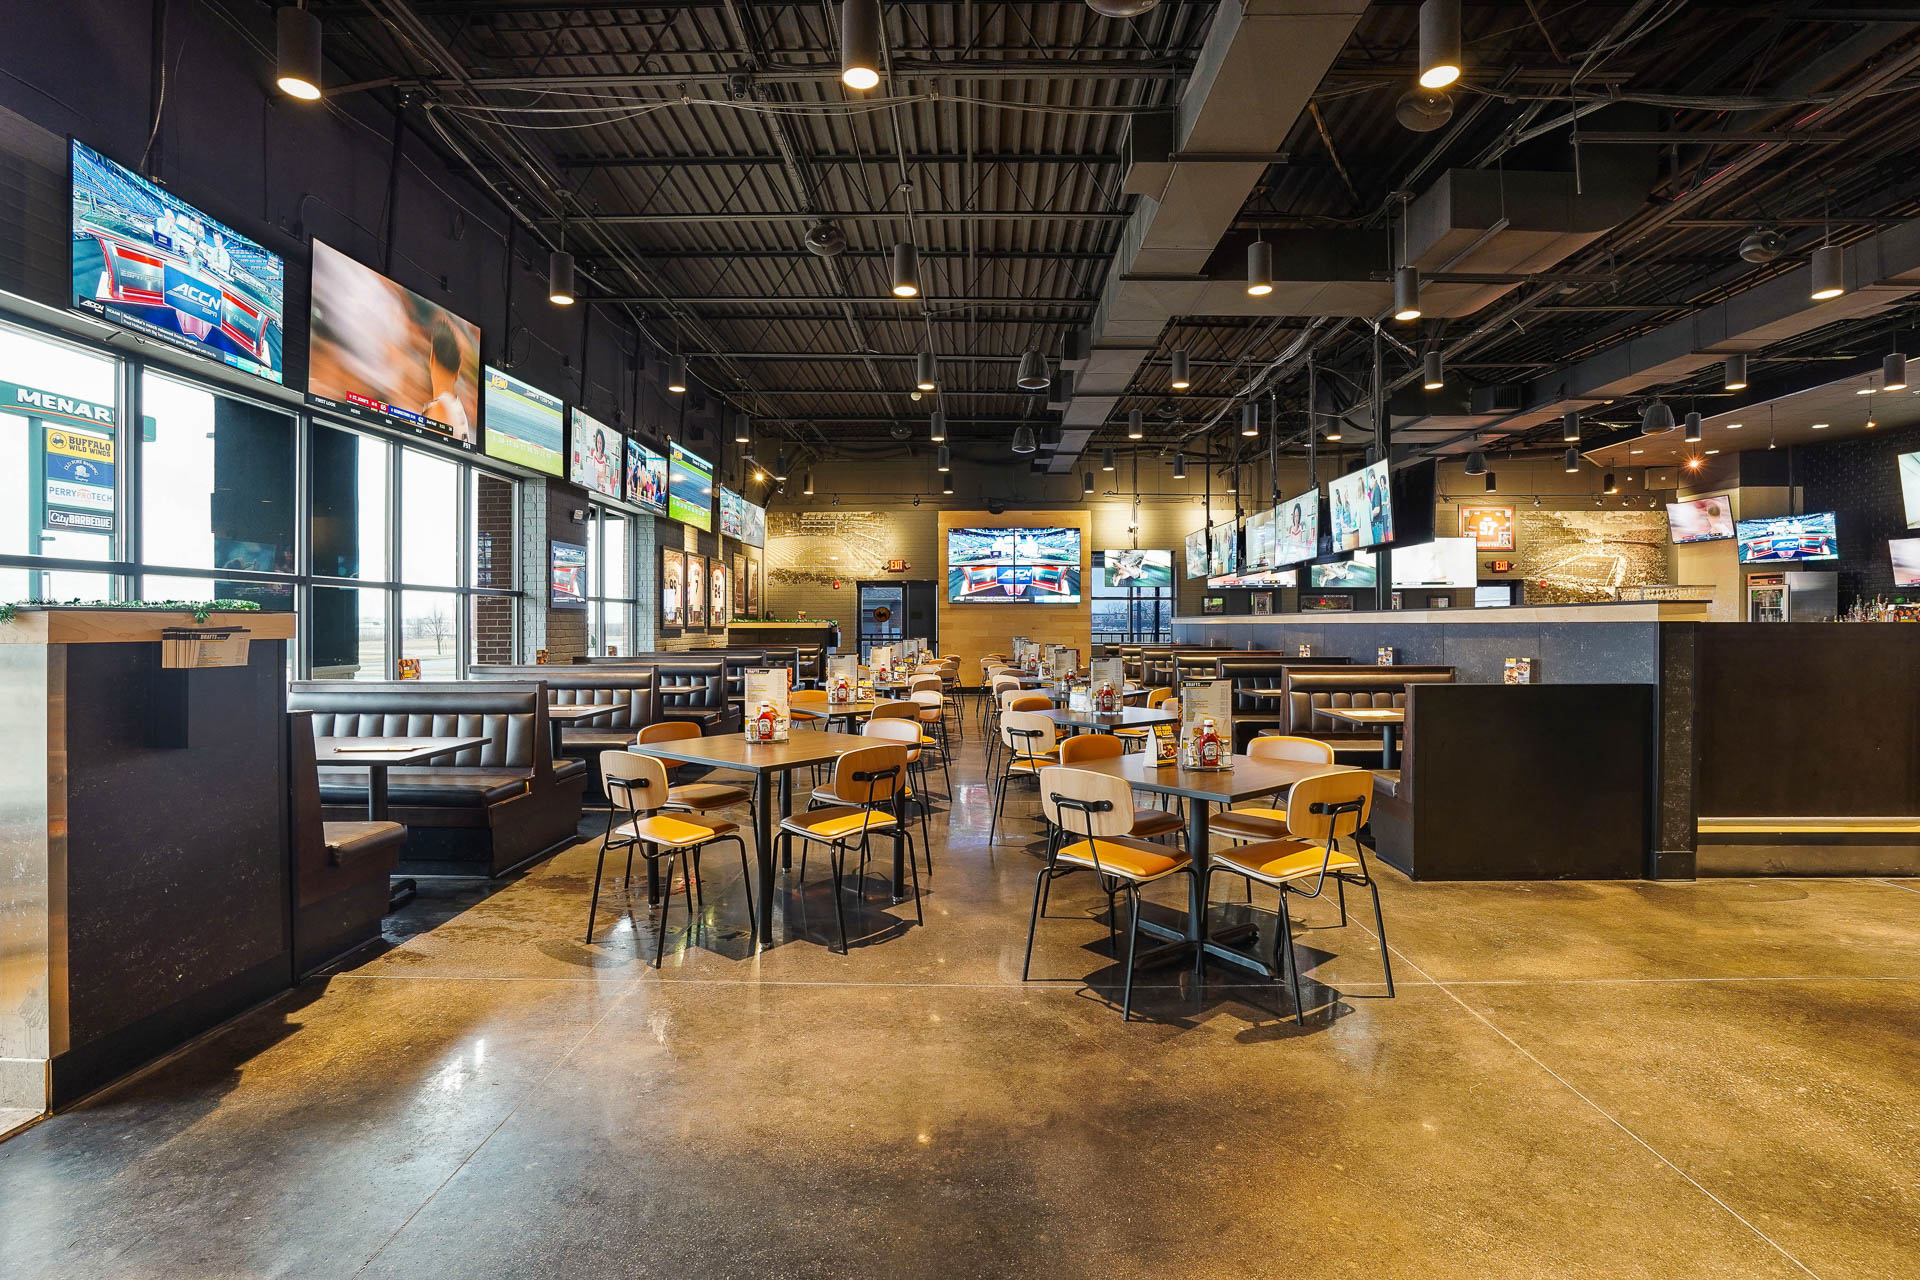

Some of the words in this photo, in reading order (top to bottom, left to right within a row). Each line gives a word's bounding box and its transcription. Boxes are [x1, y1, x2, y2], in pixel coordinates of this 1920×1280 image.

[167, 283, 221, 311] ACCN
[17, 388, 114, 422] MENAR
[69, 436, 111, 451] BUFFALO
[69, 445, 87, 453] WILD
[89, 448, 111, 457] WINGS
[50, 512, 69, 526] City
[890, 560, 903, 570] EXIT
[1495, 561, 1508, 571] EXIT
[695, 579, 699, 594] 7
